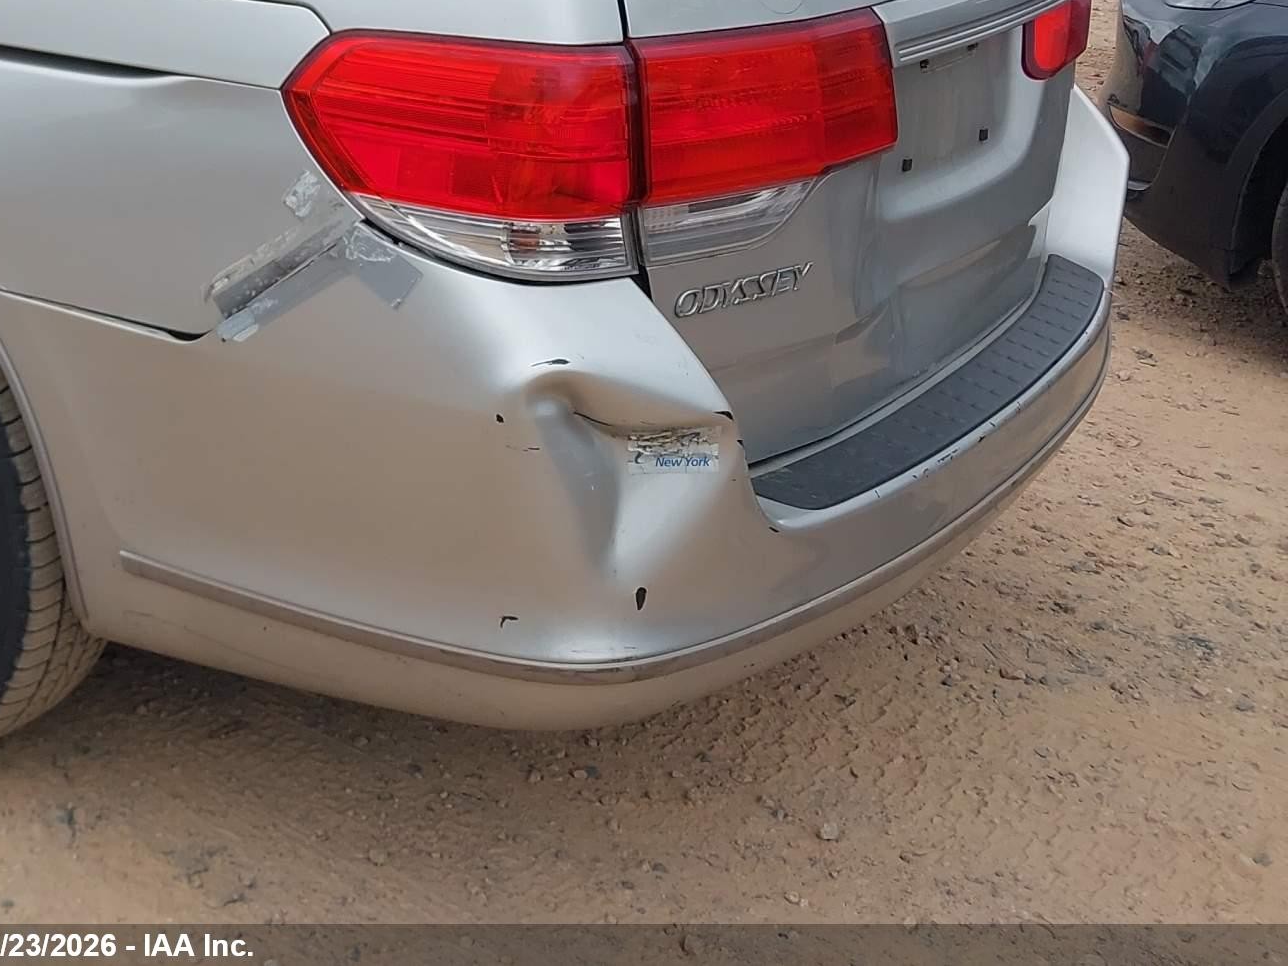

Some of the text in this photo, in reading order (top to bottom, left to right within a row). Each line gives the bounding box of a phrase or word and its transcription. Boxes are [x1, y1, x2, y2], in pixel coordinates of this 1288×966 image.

[674, 261, 814, 318] ODYSSEY
[655, 457, 710, 467] New York
